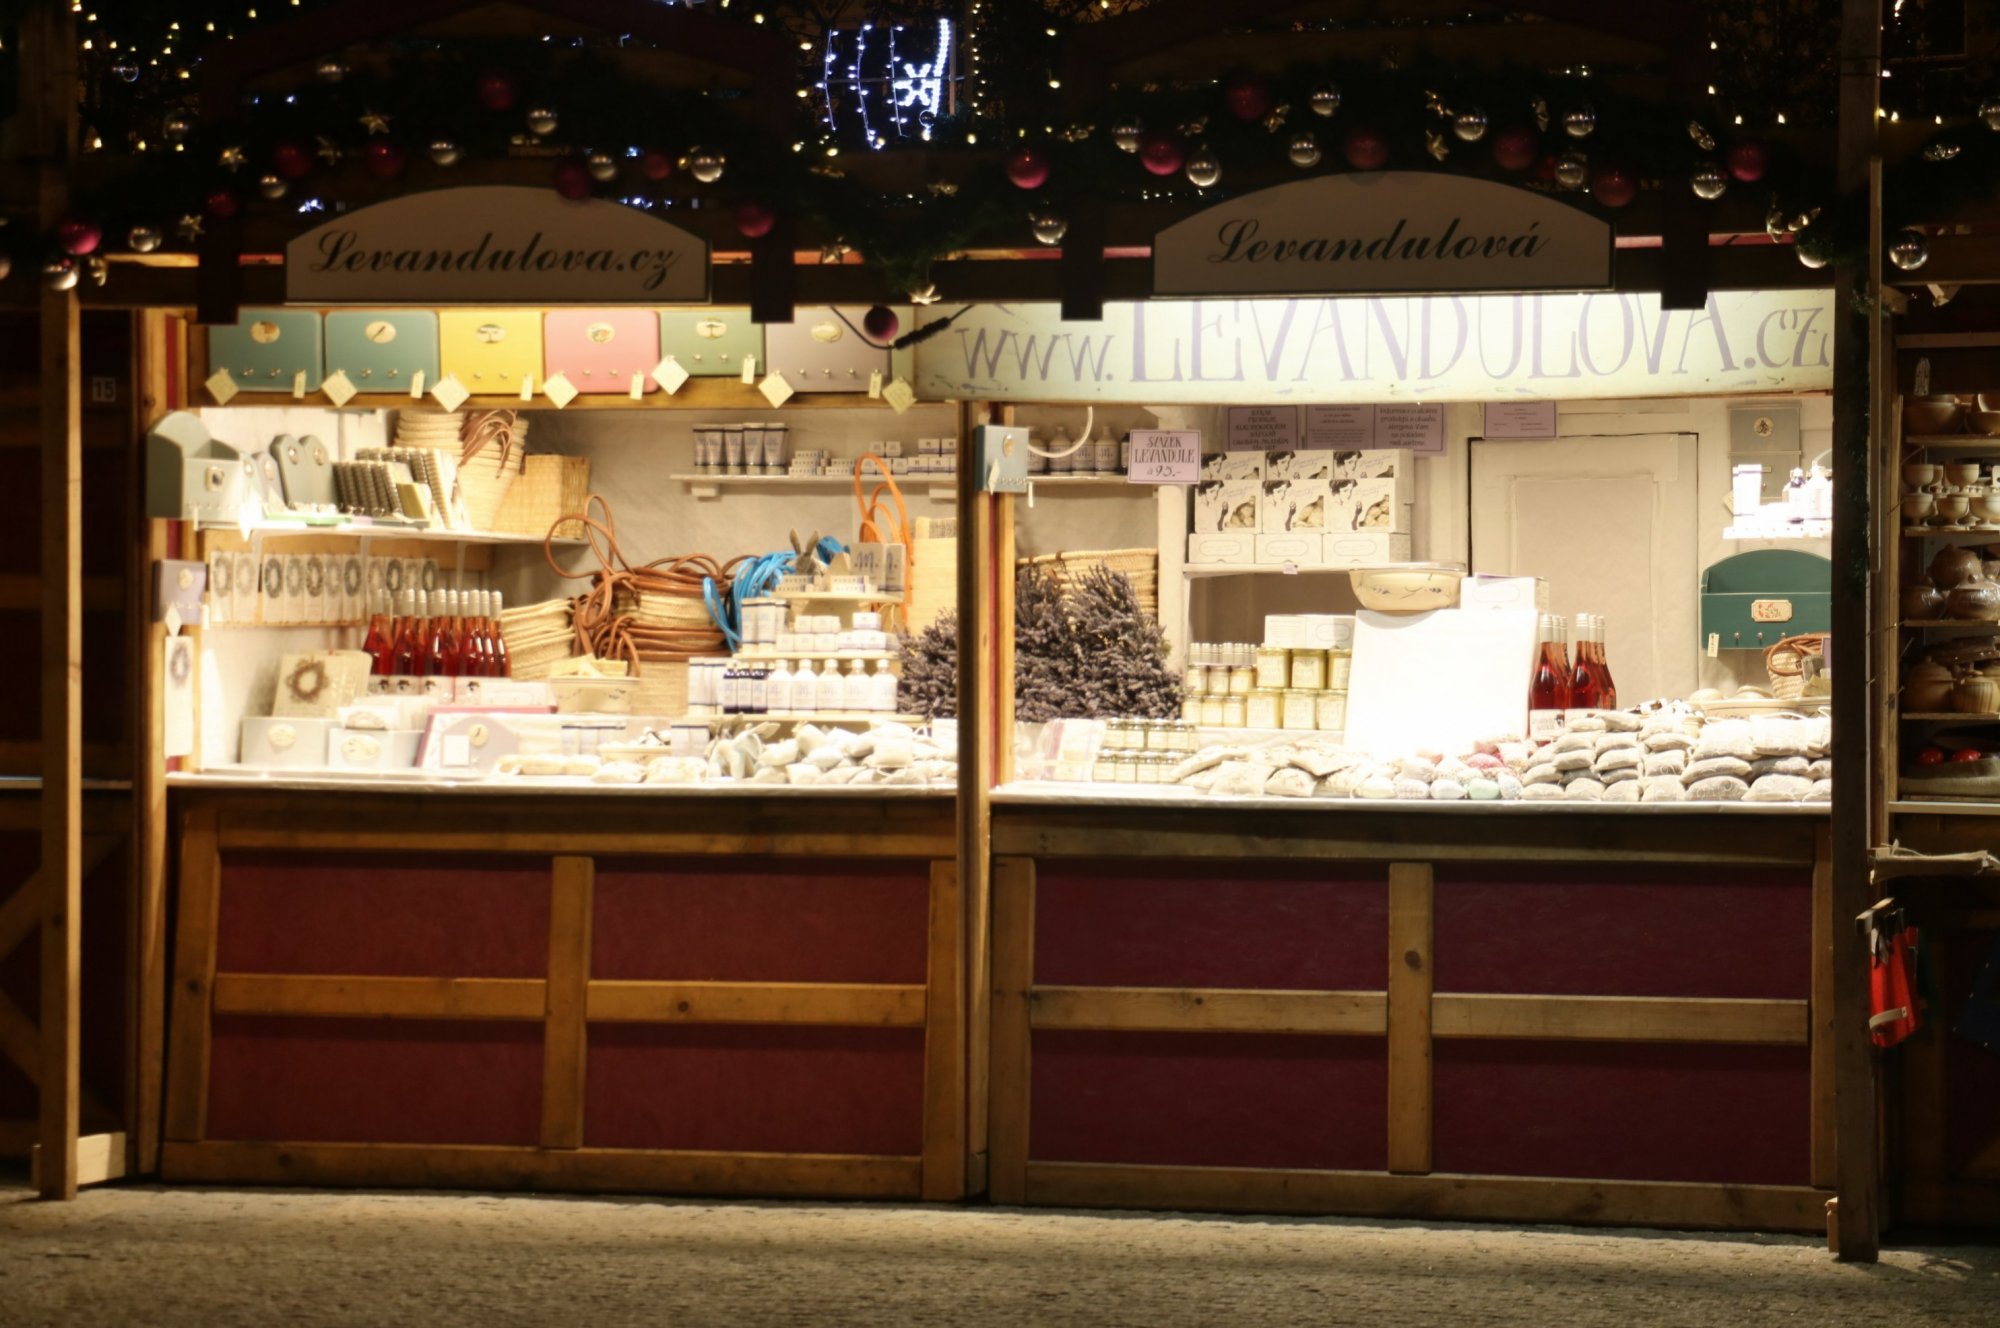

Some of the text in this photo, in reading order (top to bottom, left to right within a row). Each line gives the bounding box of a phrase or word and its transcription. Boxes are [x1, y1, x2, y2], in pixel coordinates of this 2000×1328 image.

[309, 229, 683, 291] Levandulova.cz
[1207, 217, 1551, 263] Levandulová
[1134, 448, 1195, 464] LEVANDULE
